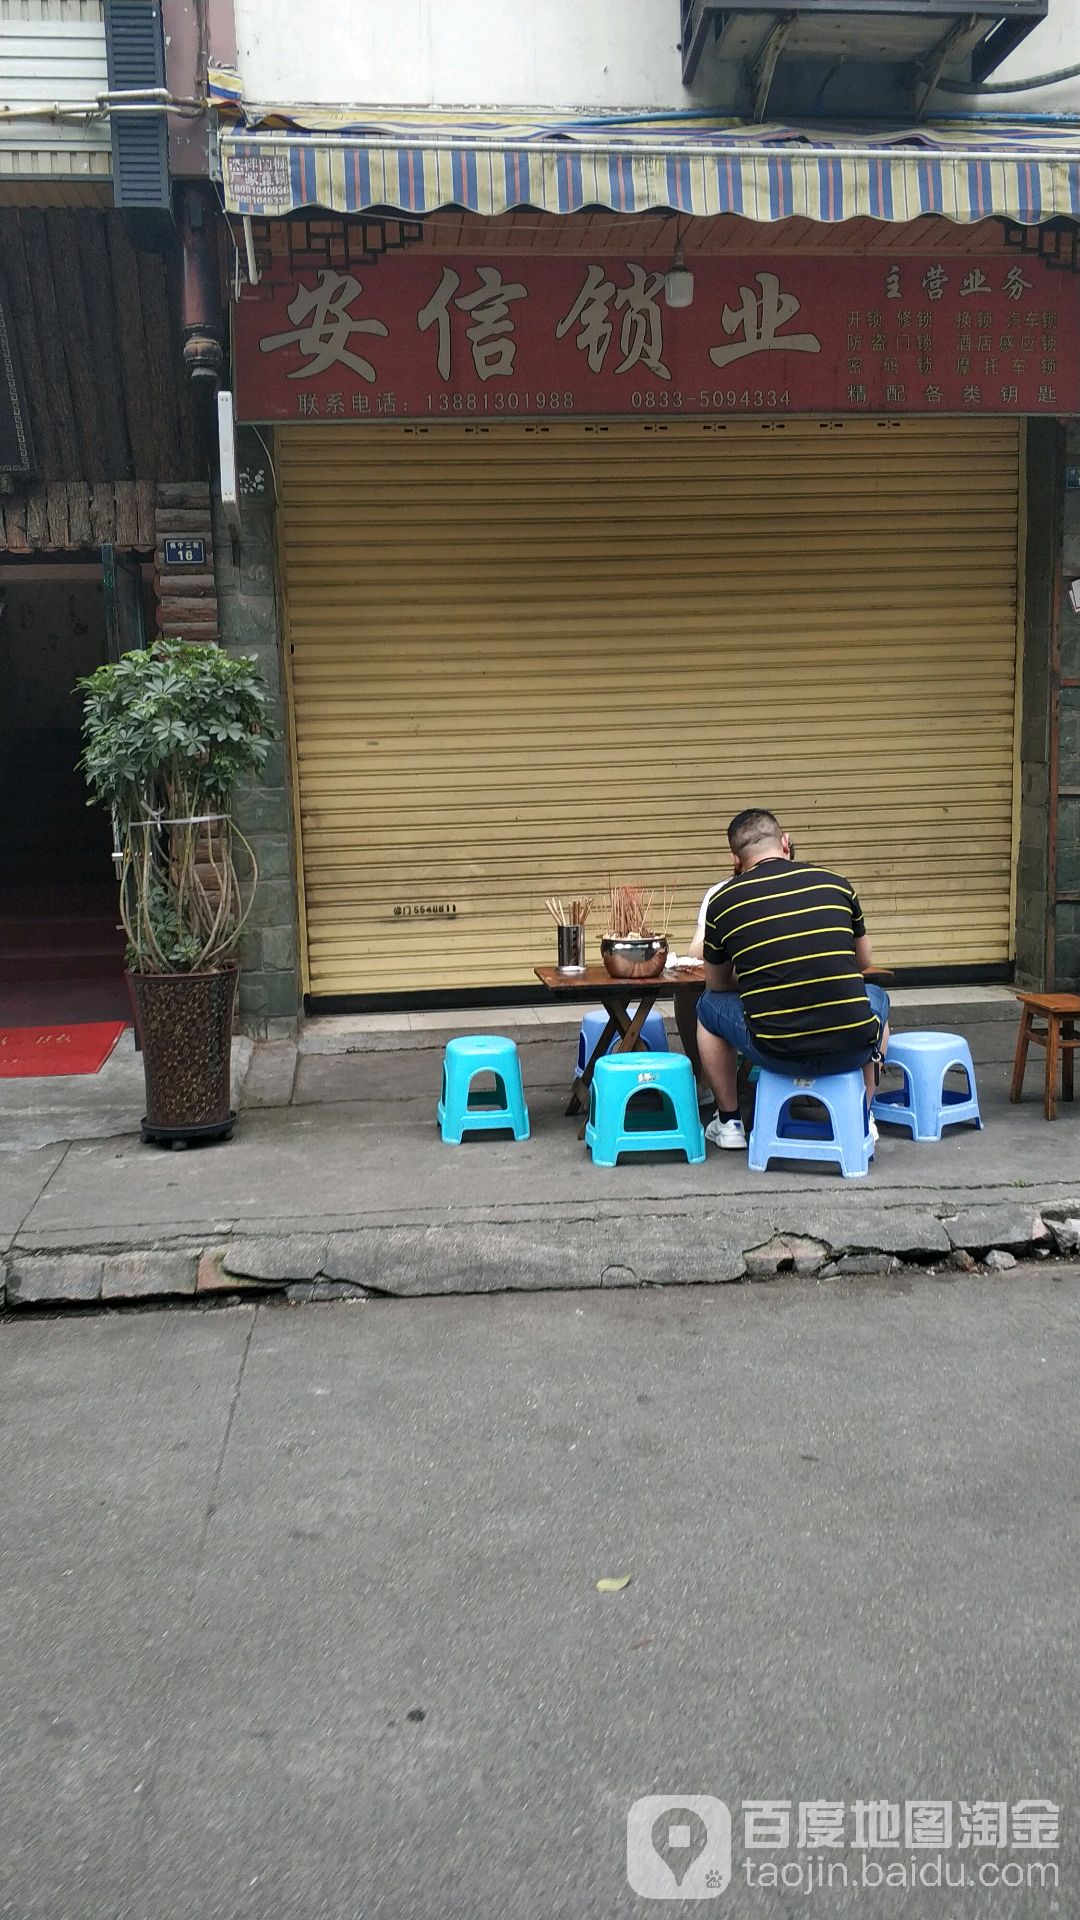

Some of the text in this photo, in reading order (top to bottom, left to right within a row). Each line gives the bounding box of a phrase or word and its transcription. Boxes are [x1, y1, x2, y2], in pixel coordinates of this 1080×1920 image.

[885, 264, 1034, 300] 主营业务
[259, 263, 821, 382] 安信锁业
[425, 391, 575, 411] 13881301988
[631, 390, 791, 408] 0833-5094334
[847, 384, 1056, 403] 精配各类钥匙
[177, 549, 193, 561] 16
